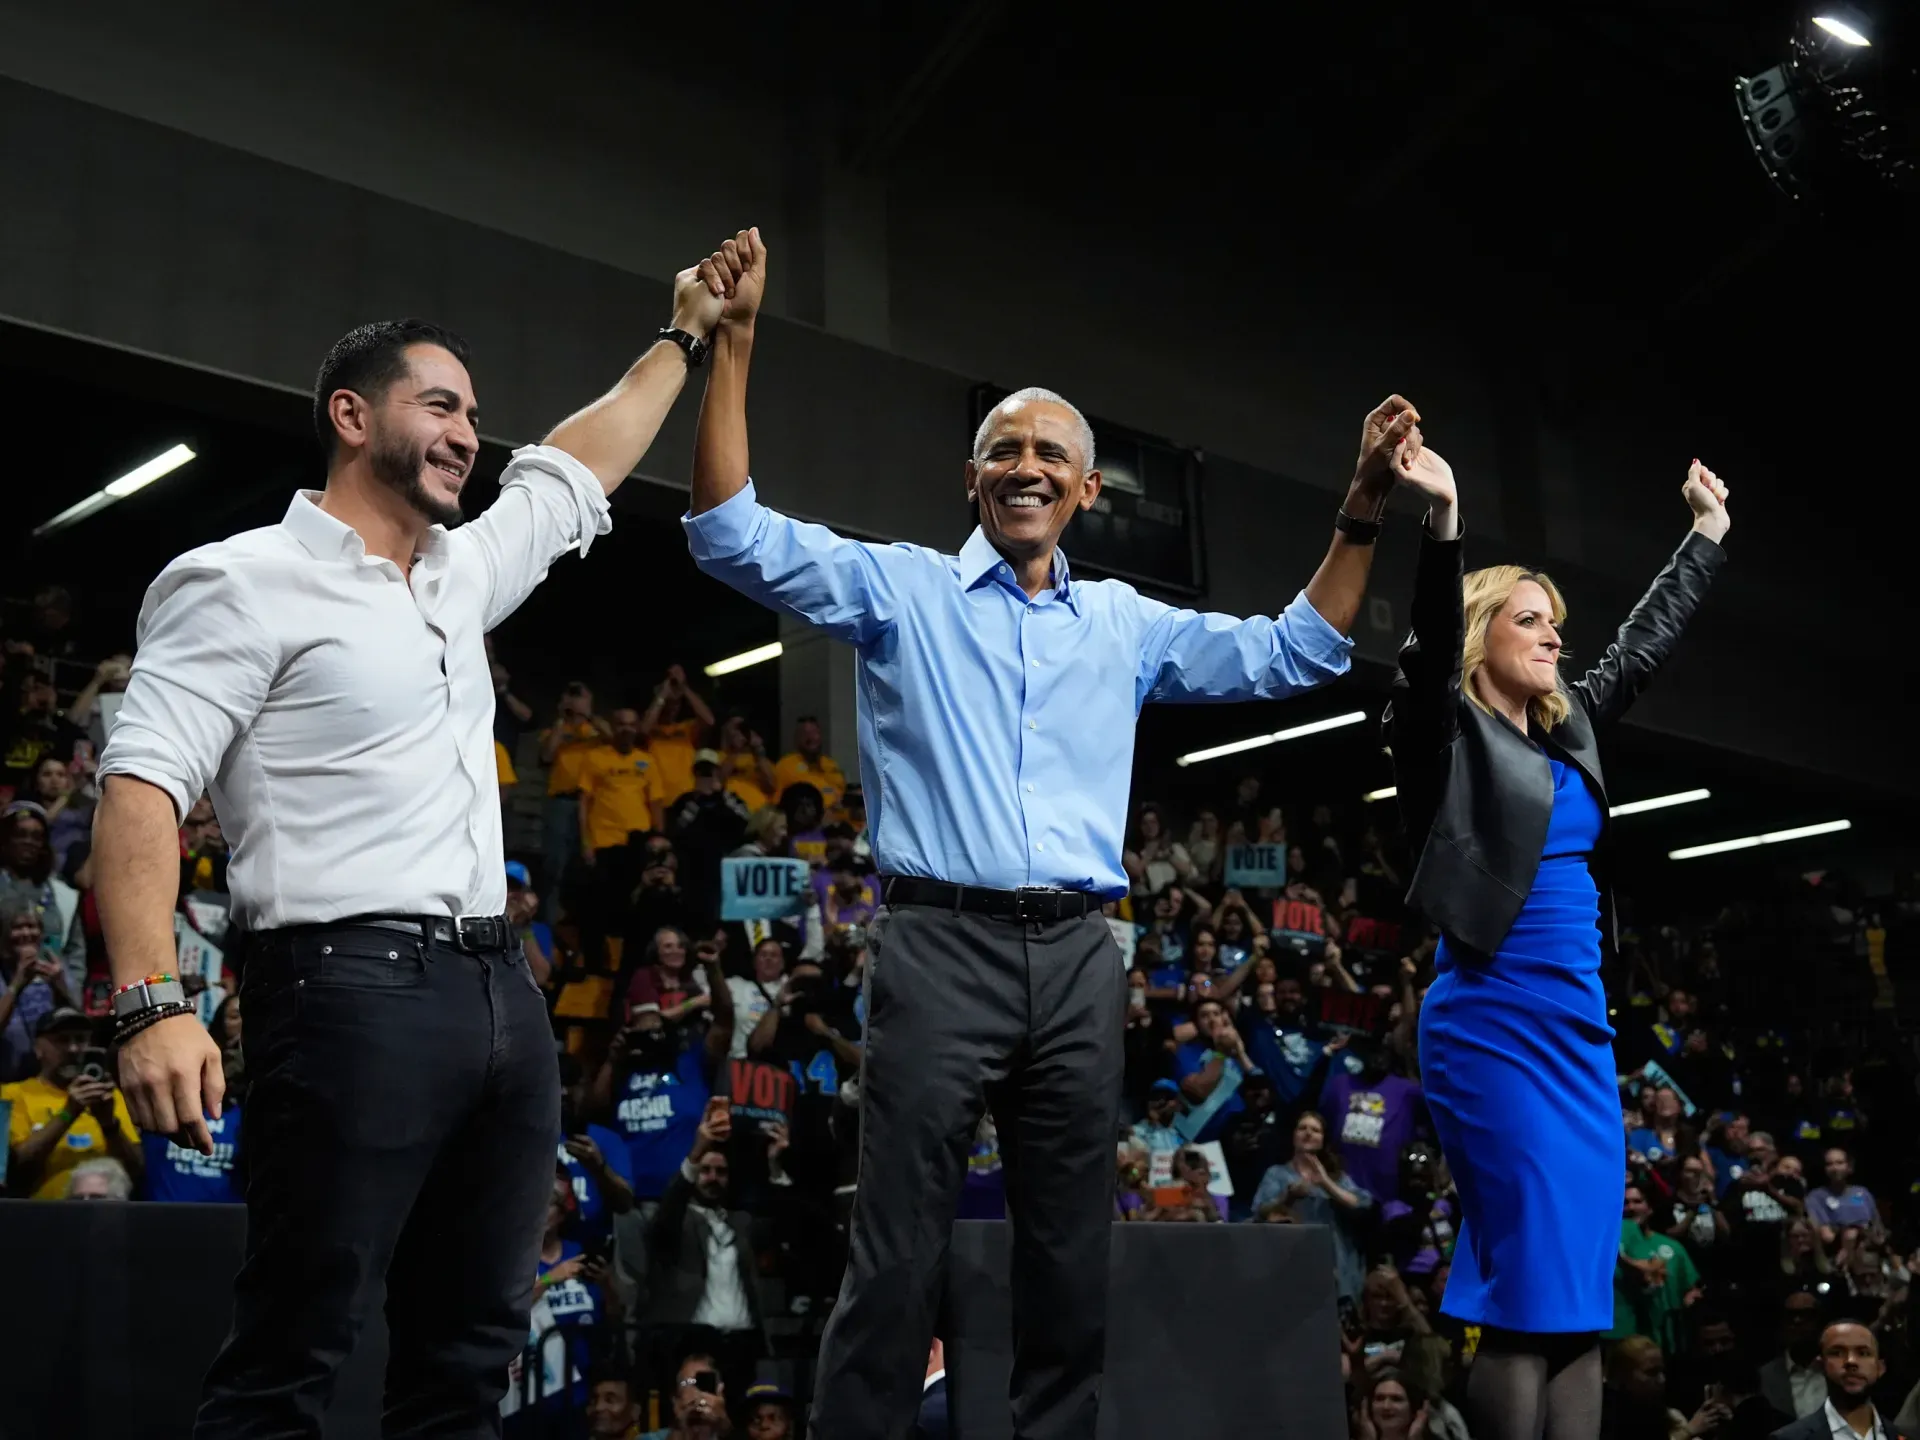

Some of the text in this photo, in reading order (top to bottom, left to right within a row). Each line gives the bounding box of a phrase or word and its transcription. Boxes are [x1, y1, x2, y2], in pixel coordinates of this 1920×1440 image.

[1232, 846, 1276, 870] VOTE
[734, 864, 800, 897] VOTE
[1272, 899, 1325, 936] VOTE
[547, 1291, 586, 1308] WER
